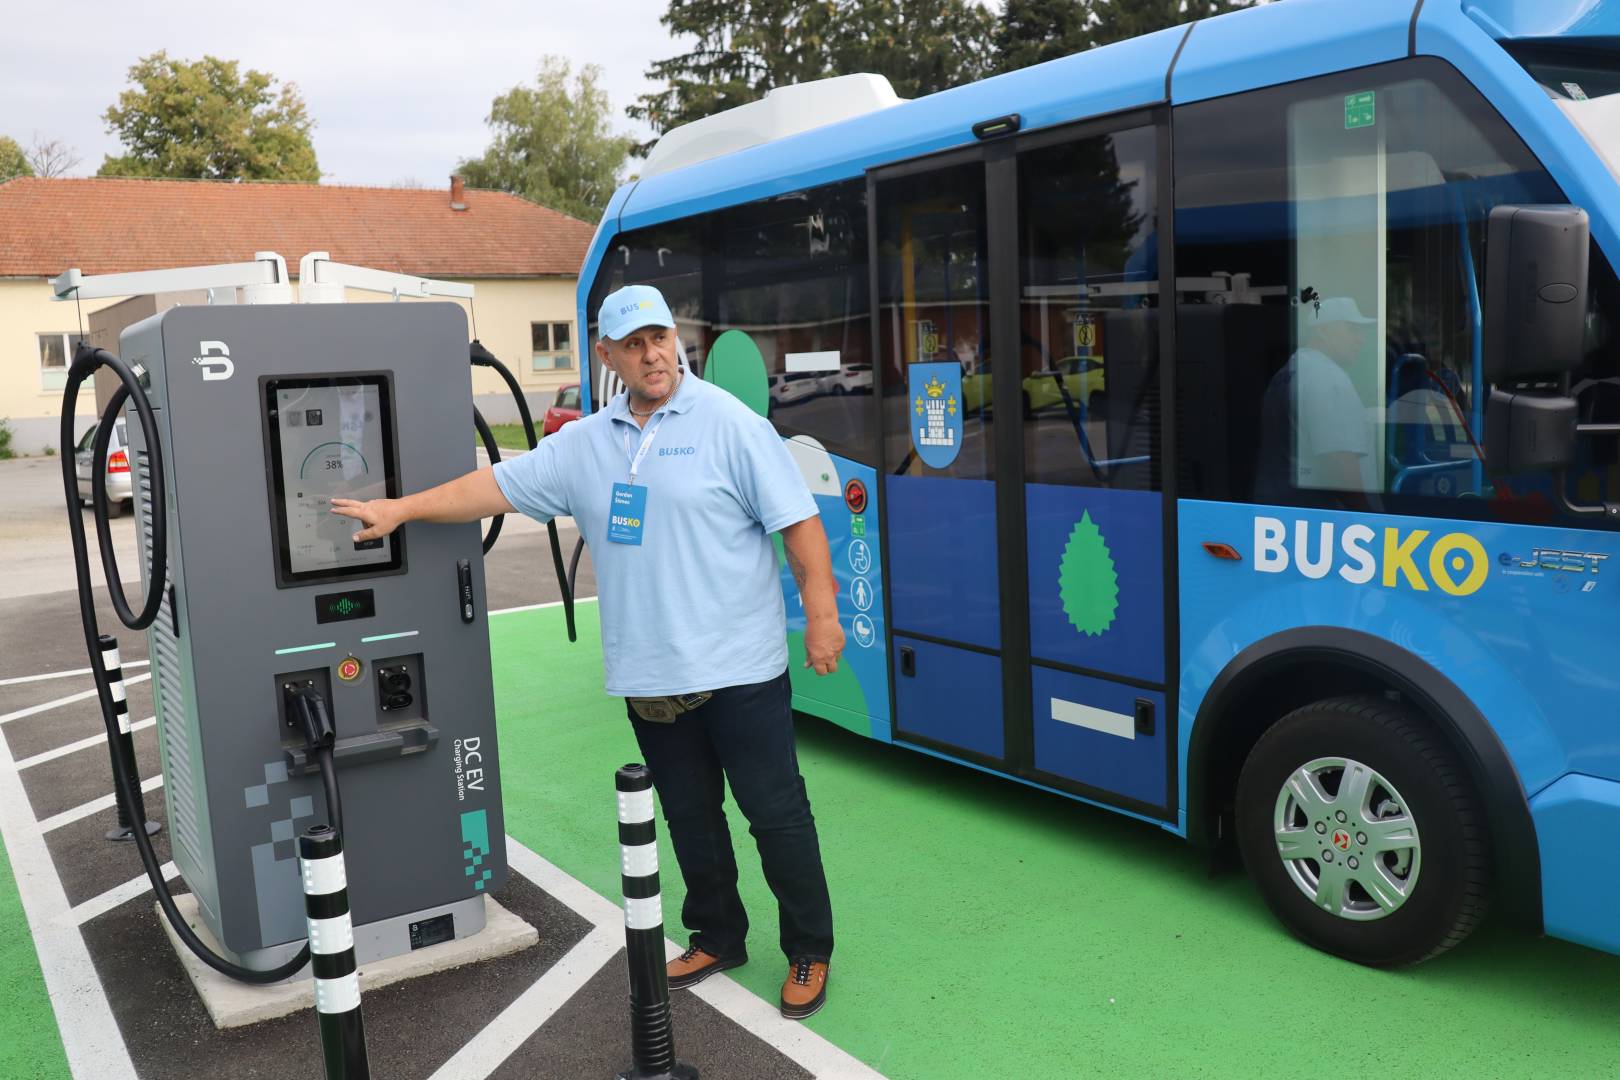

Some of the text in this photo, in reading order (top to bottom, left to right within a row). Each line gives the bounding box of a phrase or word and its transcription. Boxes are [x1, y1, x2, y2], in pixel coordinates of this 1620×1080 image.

[620, 300, 653, 315] BUS
[658, 446, 695, 457] BUSKO
[325, 460, 343, 470] 38%
[612, 515, 641, 527] BUSKO
[1253, 516, 1489, 596] BUSKO
[453, 739, 465, 801] Charging Station
[463, 736, 485, 791] DC EV
